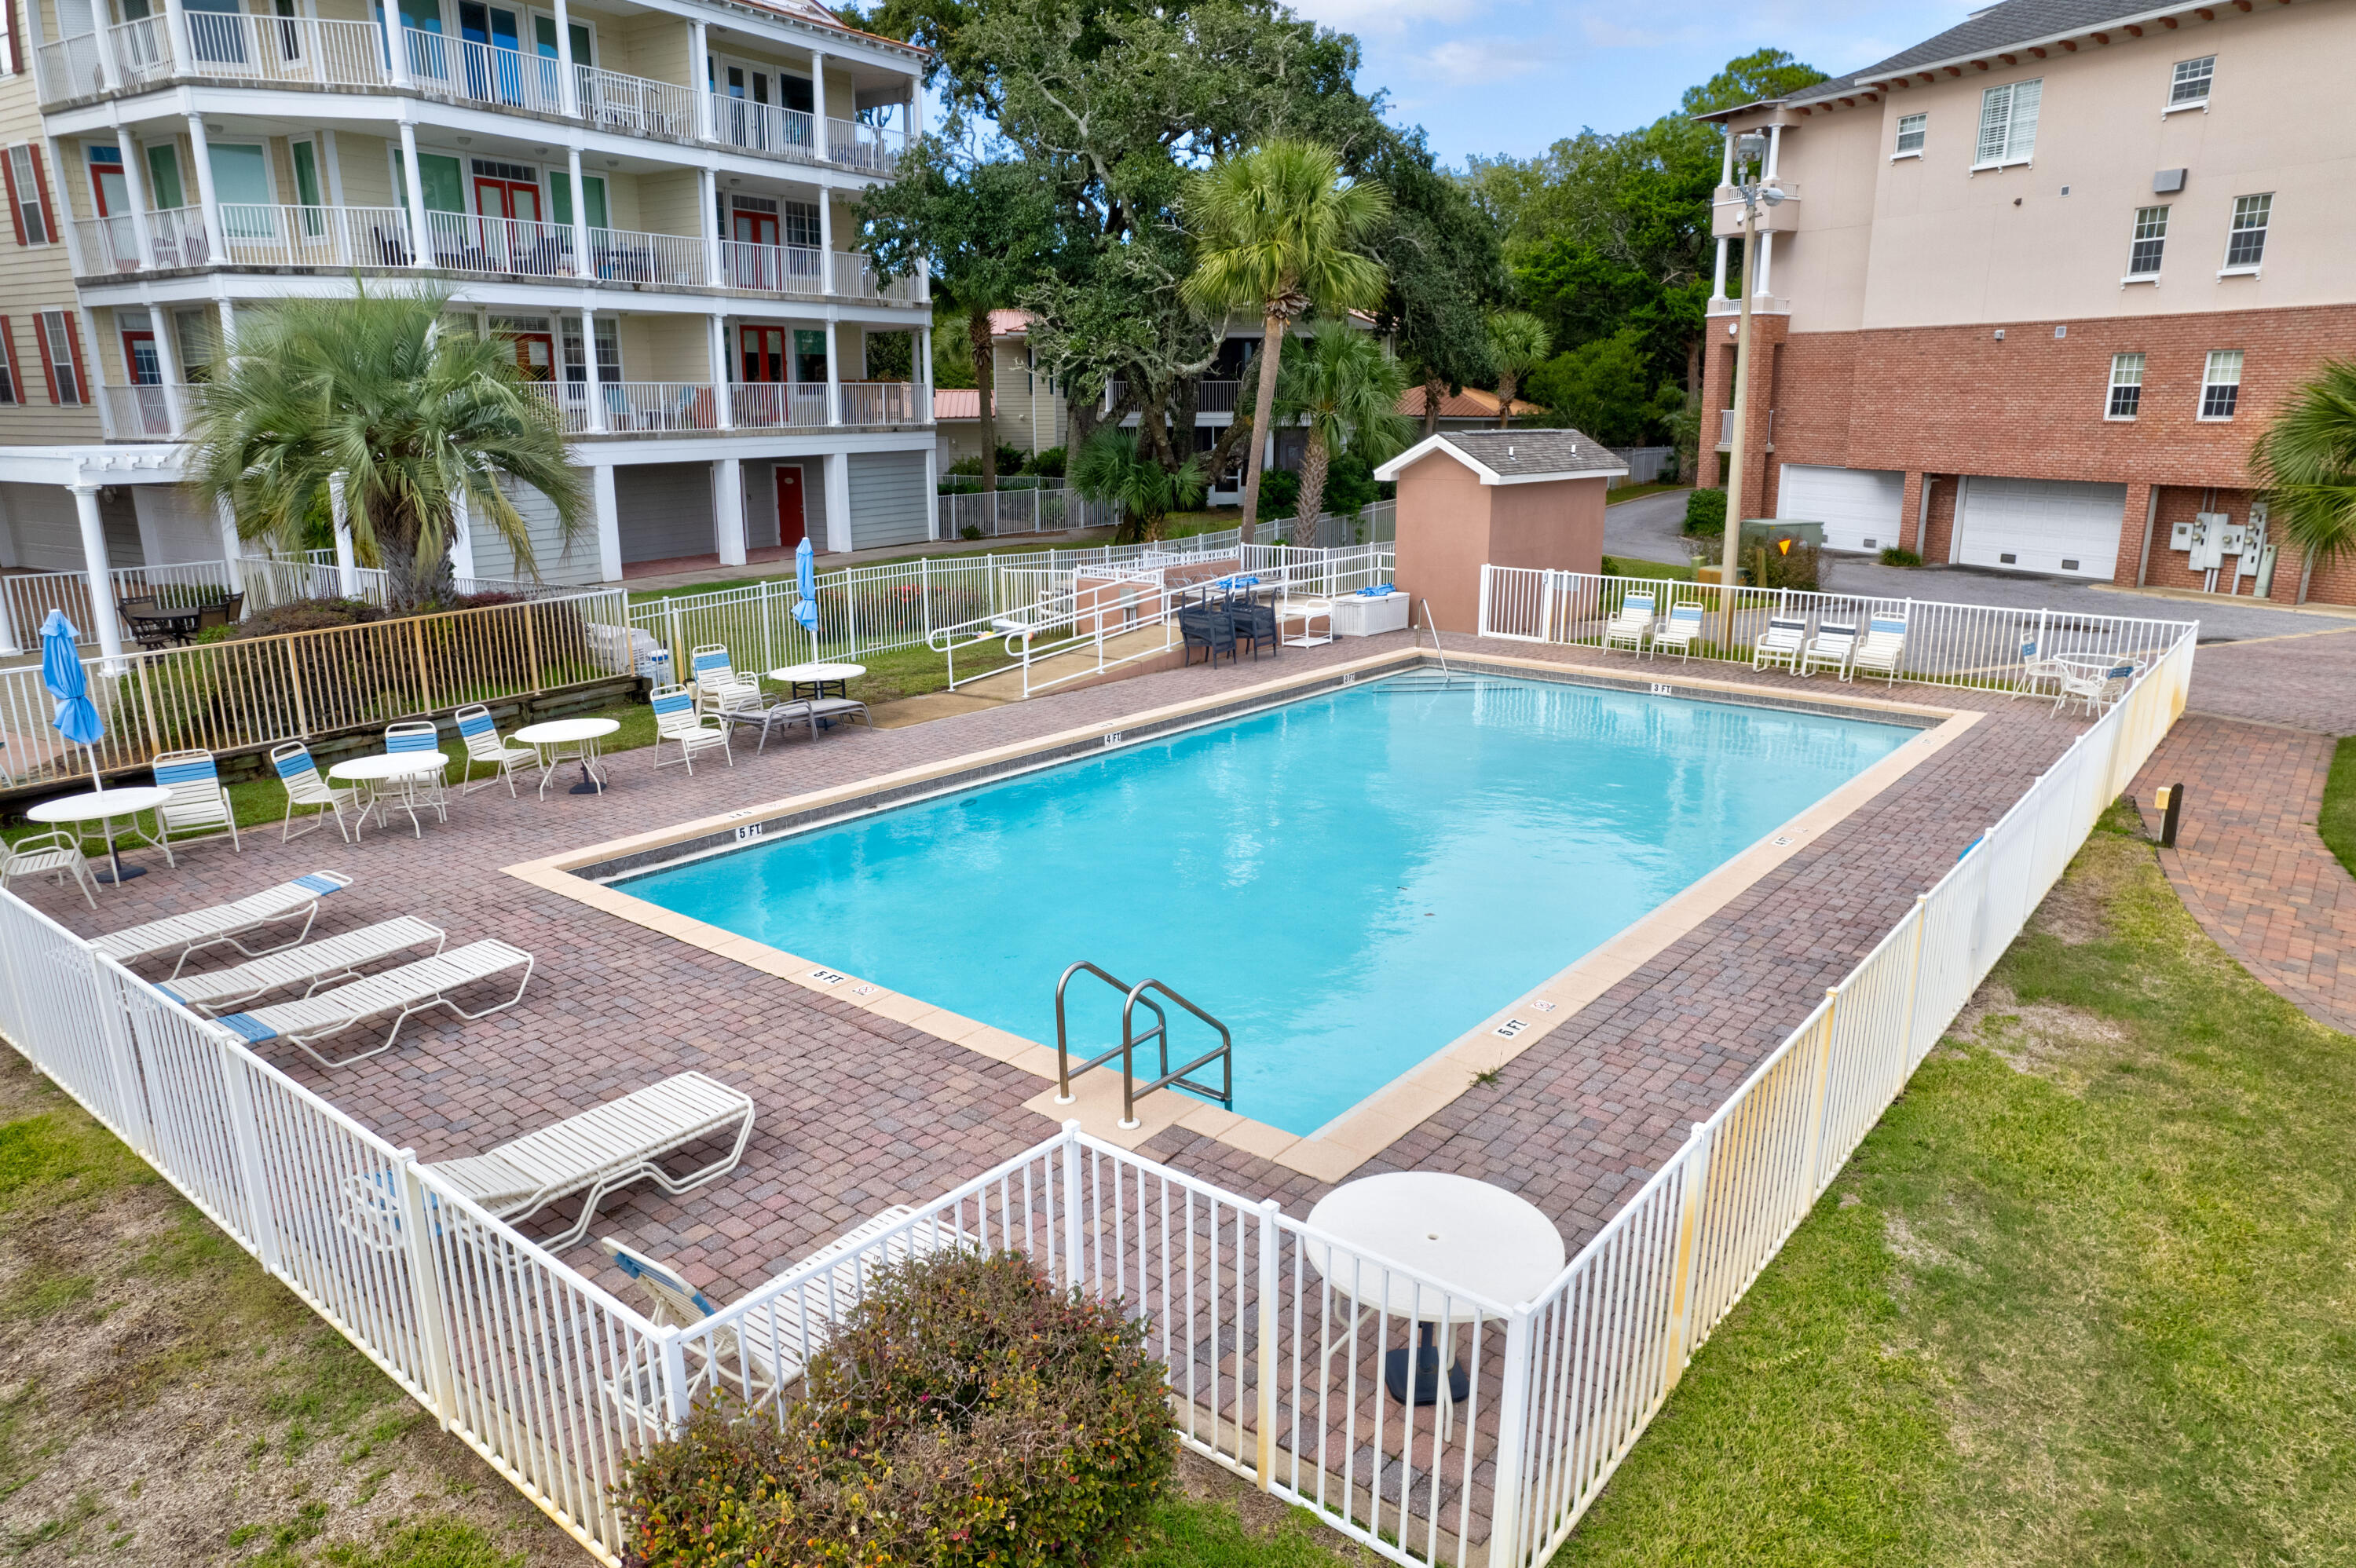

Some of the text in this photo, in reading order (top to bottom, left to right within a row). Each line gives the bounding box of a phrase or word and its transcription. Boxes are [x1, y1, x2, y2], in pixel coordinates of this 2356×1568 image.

[1107, 735, 1110, 744] 4
[740, 828, 745, 839] 5
[1498, 1028, 1513, 1036] 5
